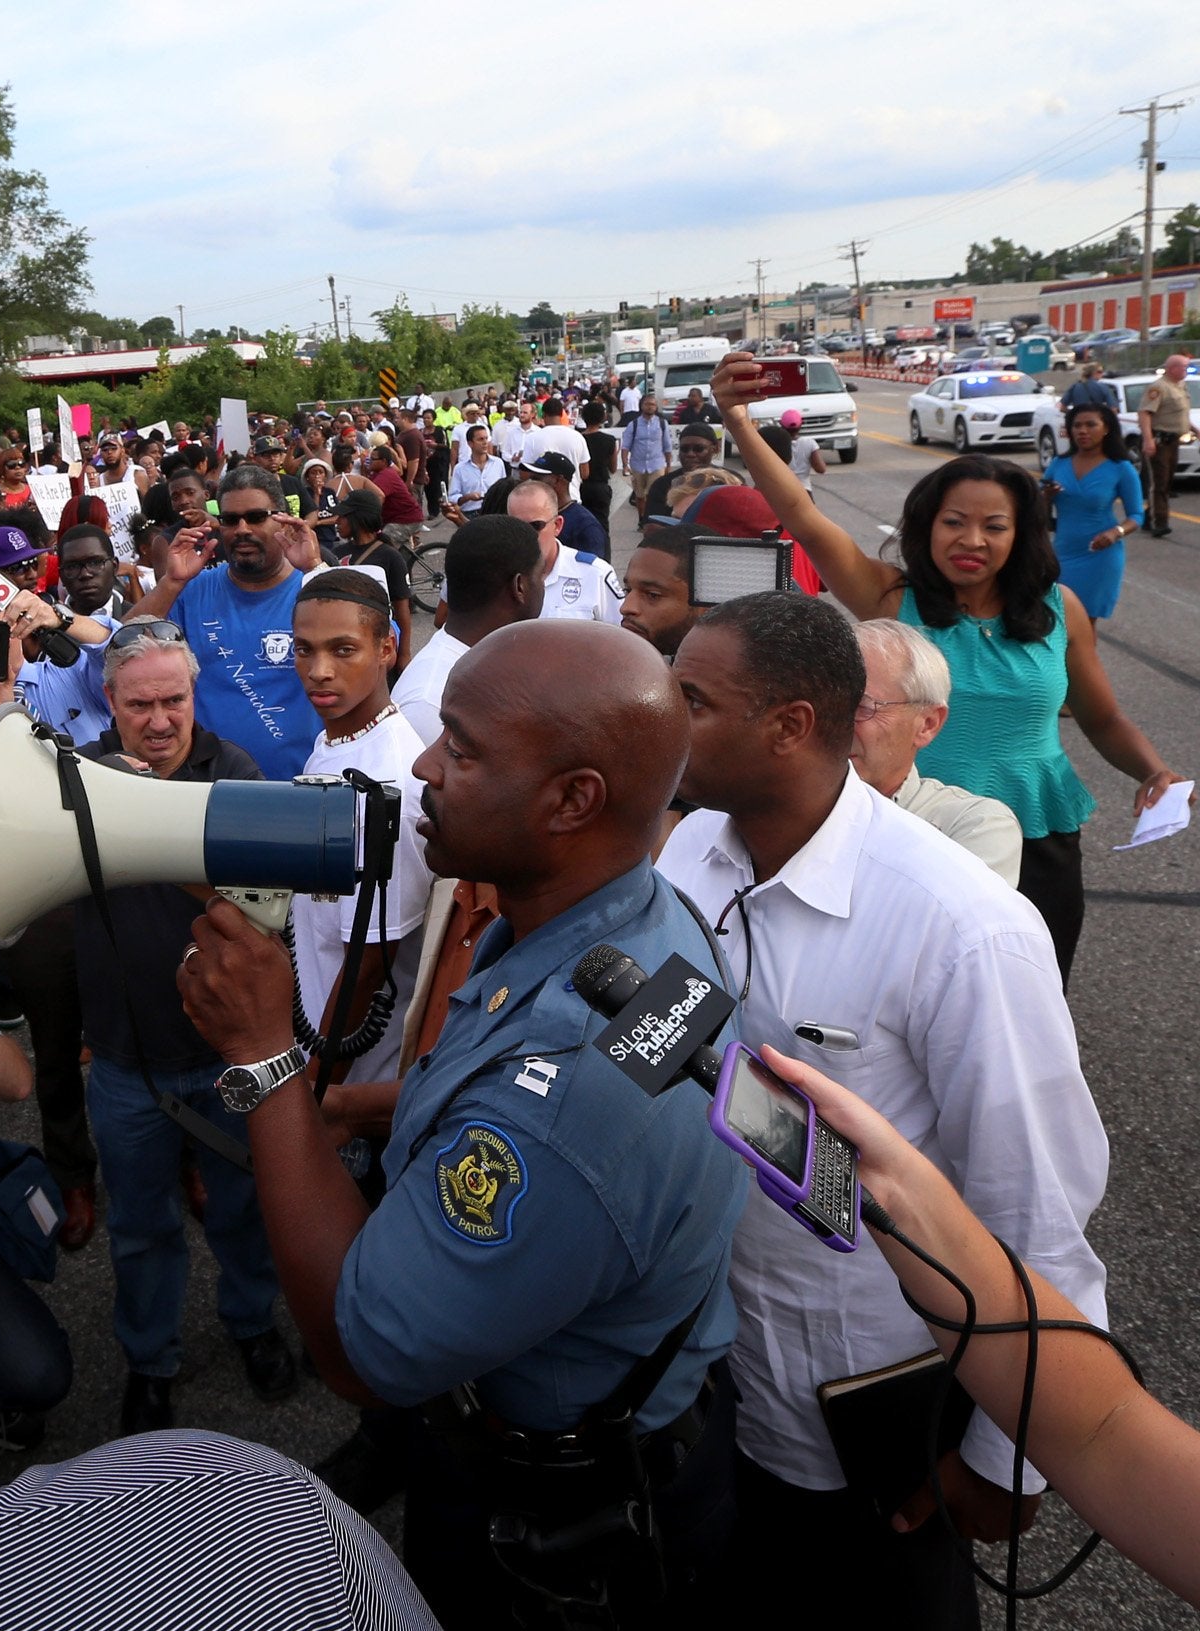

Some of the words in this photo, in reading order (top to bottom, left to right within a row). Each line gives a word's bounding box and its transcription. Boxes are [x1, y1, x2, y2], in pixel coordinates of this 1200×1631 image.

[45, 481, 58, 500] Are
[267, 645, 287, 654] BLF
[202, 619, 223, 643] I'm
[226, 662, 285, 740] Nonviolence
[650, 1050, 665, 1066] 90.7
[664, 1024, 688, 1051] KWMU
[468, 1130, 507, 1155] MISSOURI
[503, 1153, 520, 1184] STATE
[440, 1164, 458, 1218] HIGHWAY
[458, 1217, 498, 1237] PATROL
